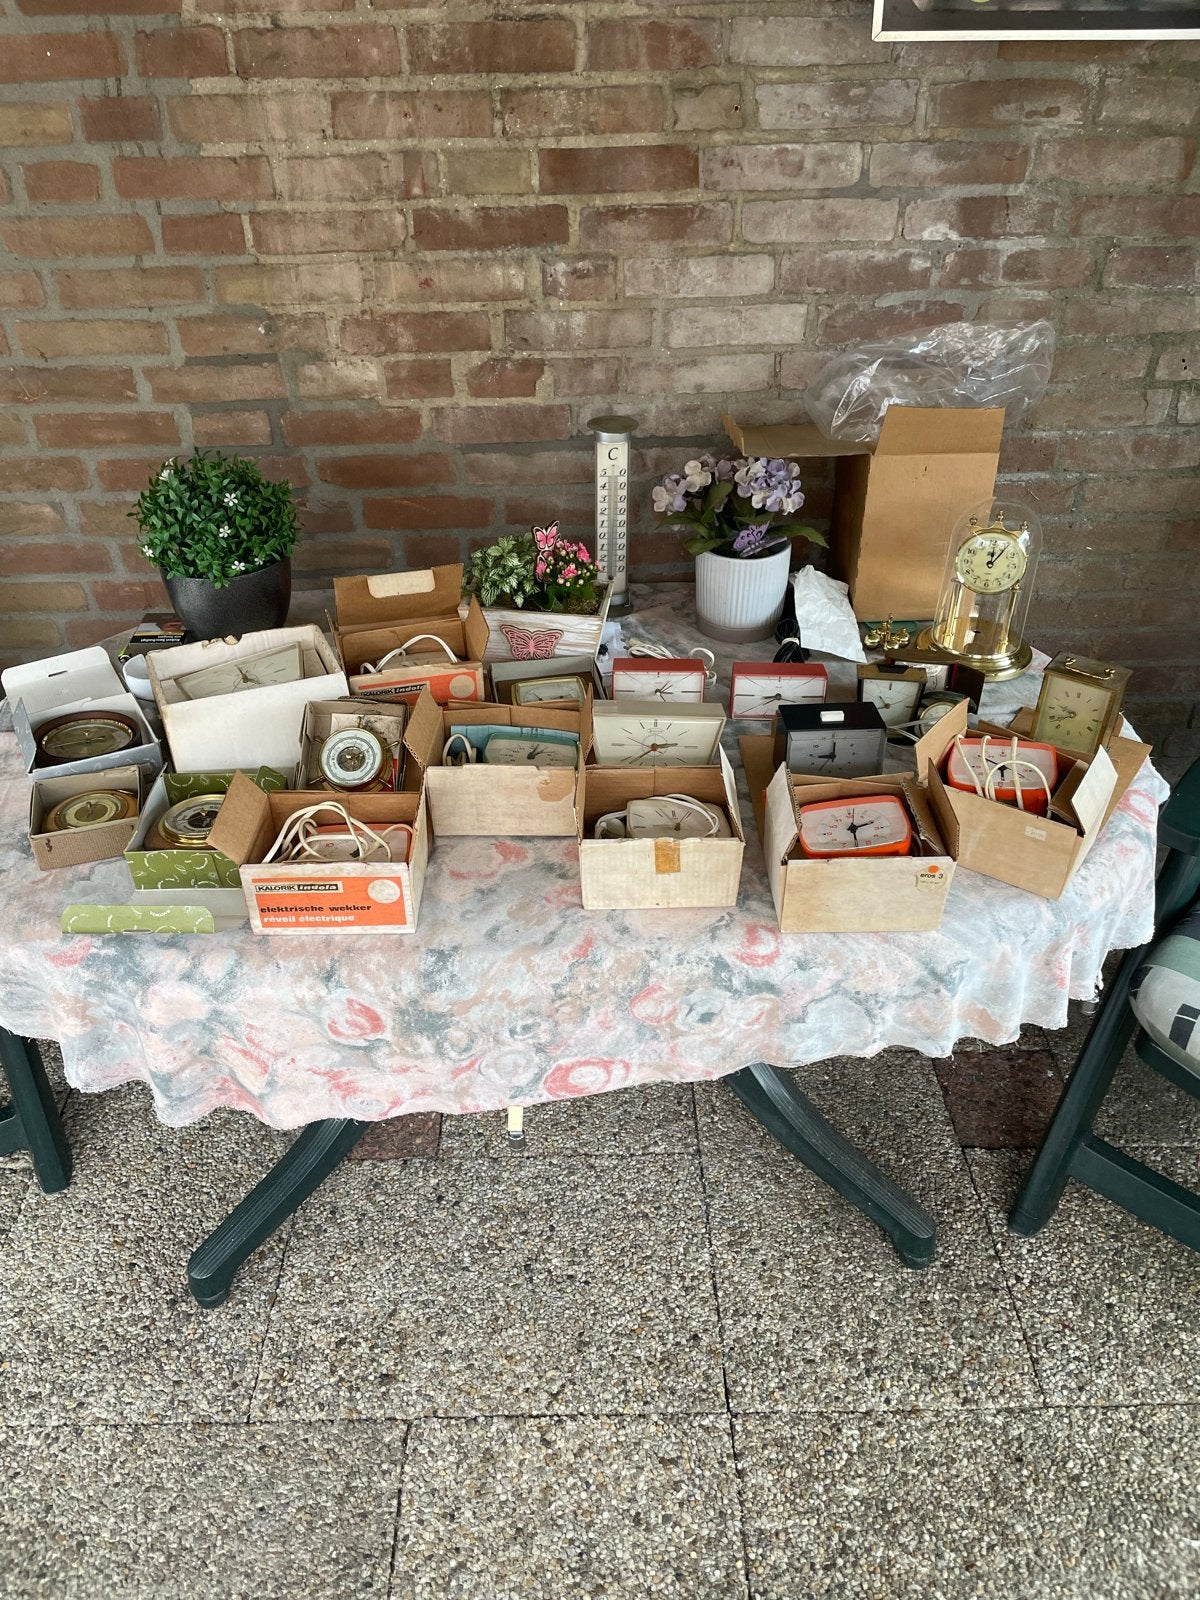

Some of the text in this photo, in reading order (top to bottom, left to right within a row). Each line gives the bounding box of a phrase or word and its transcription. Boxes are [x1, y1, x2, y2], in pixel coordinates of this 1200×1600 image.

[608, 447, 618, 460] C
[260, 904, 372, 913] elektrische wekker
[263, 914, 355, 923] réveil électrique
